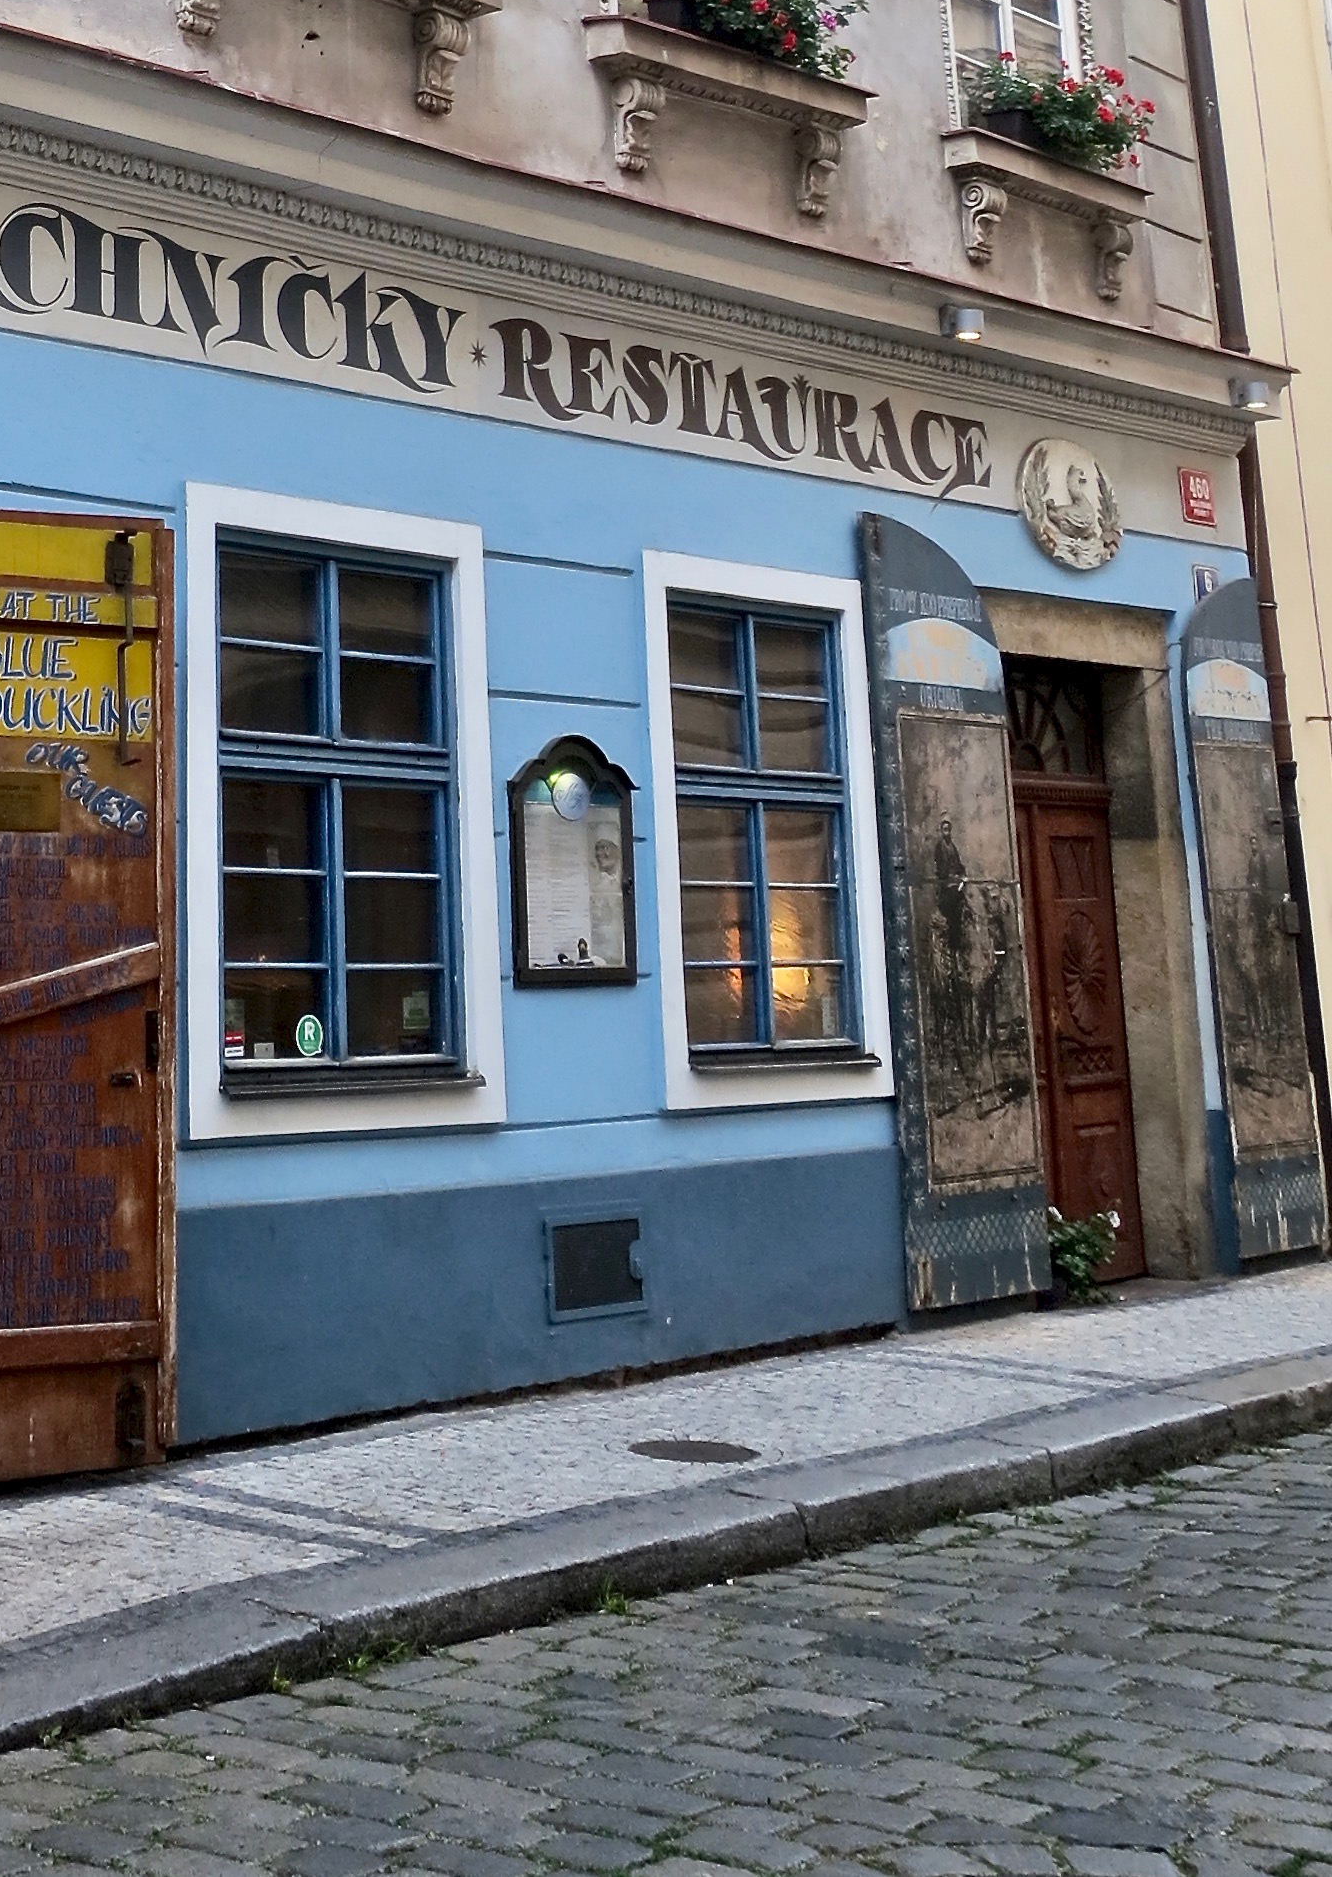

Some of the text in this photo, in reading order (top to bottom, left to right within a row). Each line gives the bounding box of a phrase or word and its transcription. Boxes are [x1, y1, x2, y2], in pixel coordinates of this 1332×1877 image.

[488, 318, 993, 510] RESTAURACE
[1189, 475, 1209, 500] 460
[1204, 571, 1214, 593] 6
[0, 593, 100, 624] AT THE
[304, 1021, 316, 1041] R
